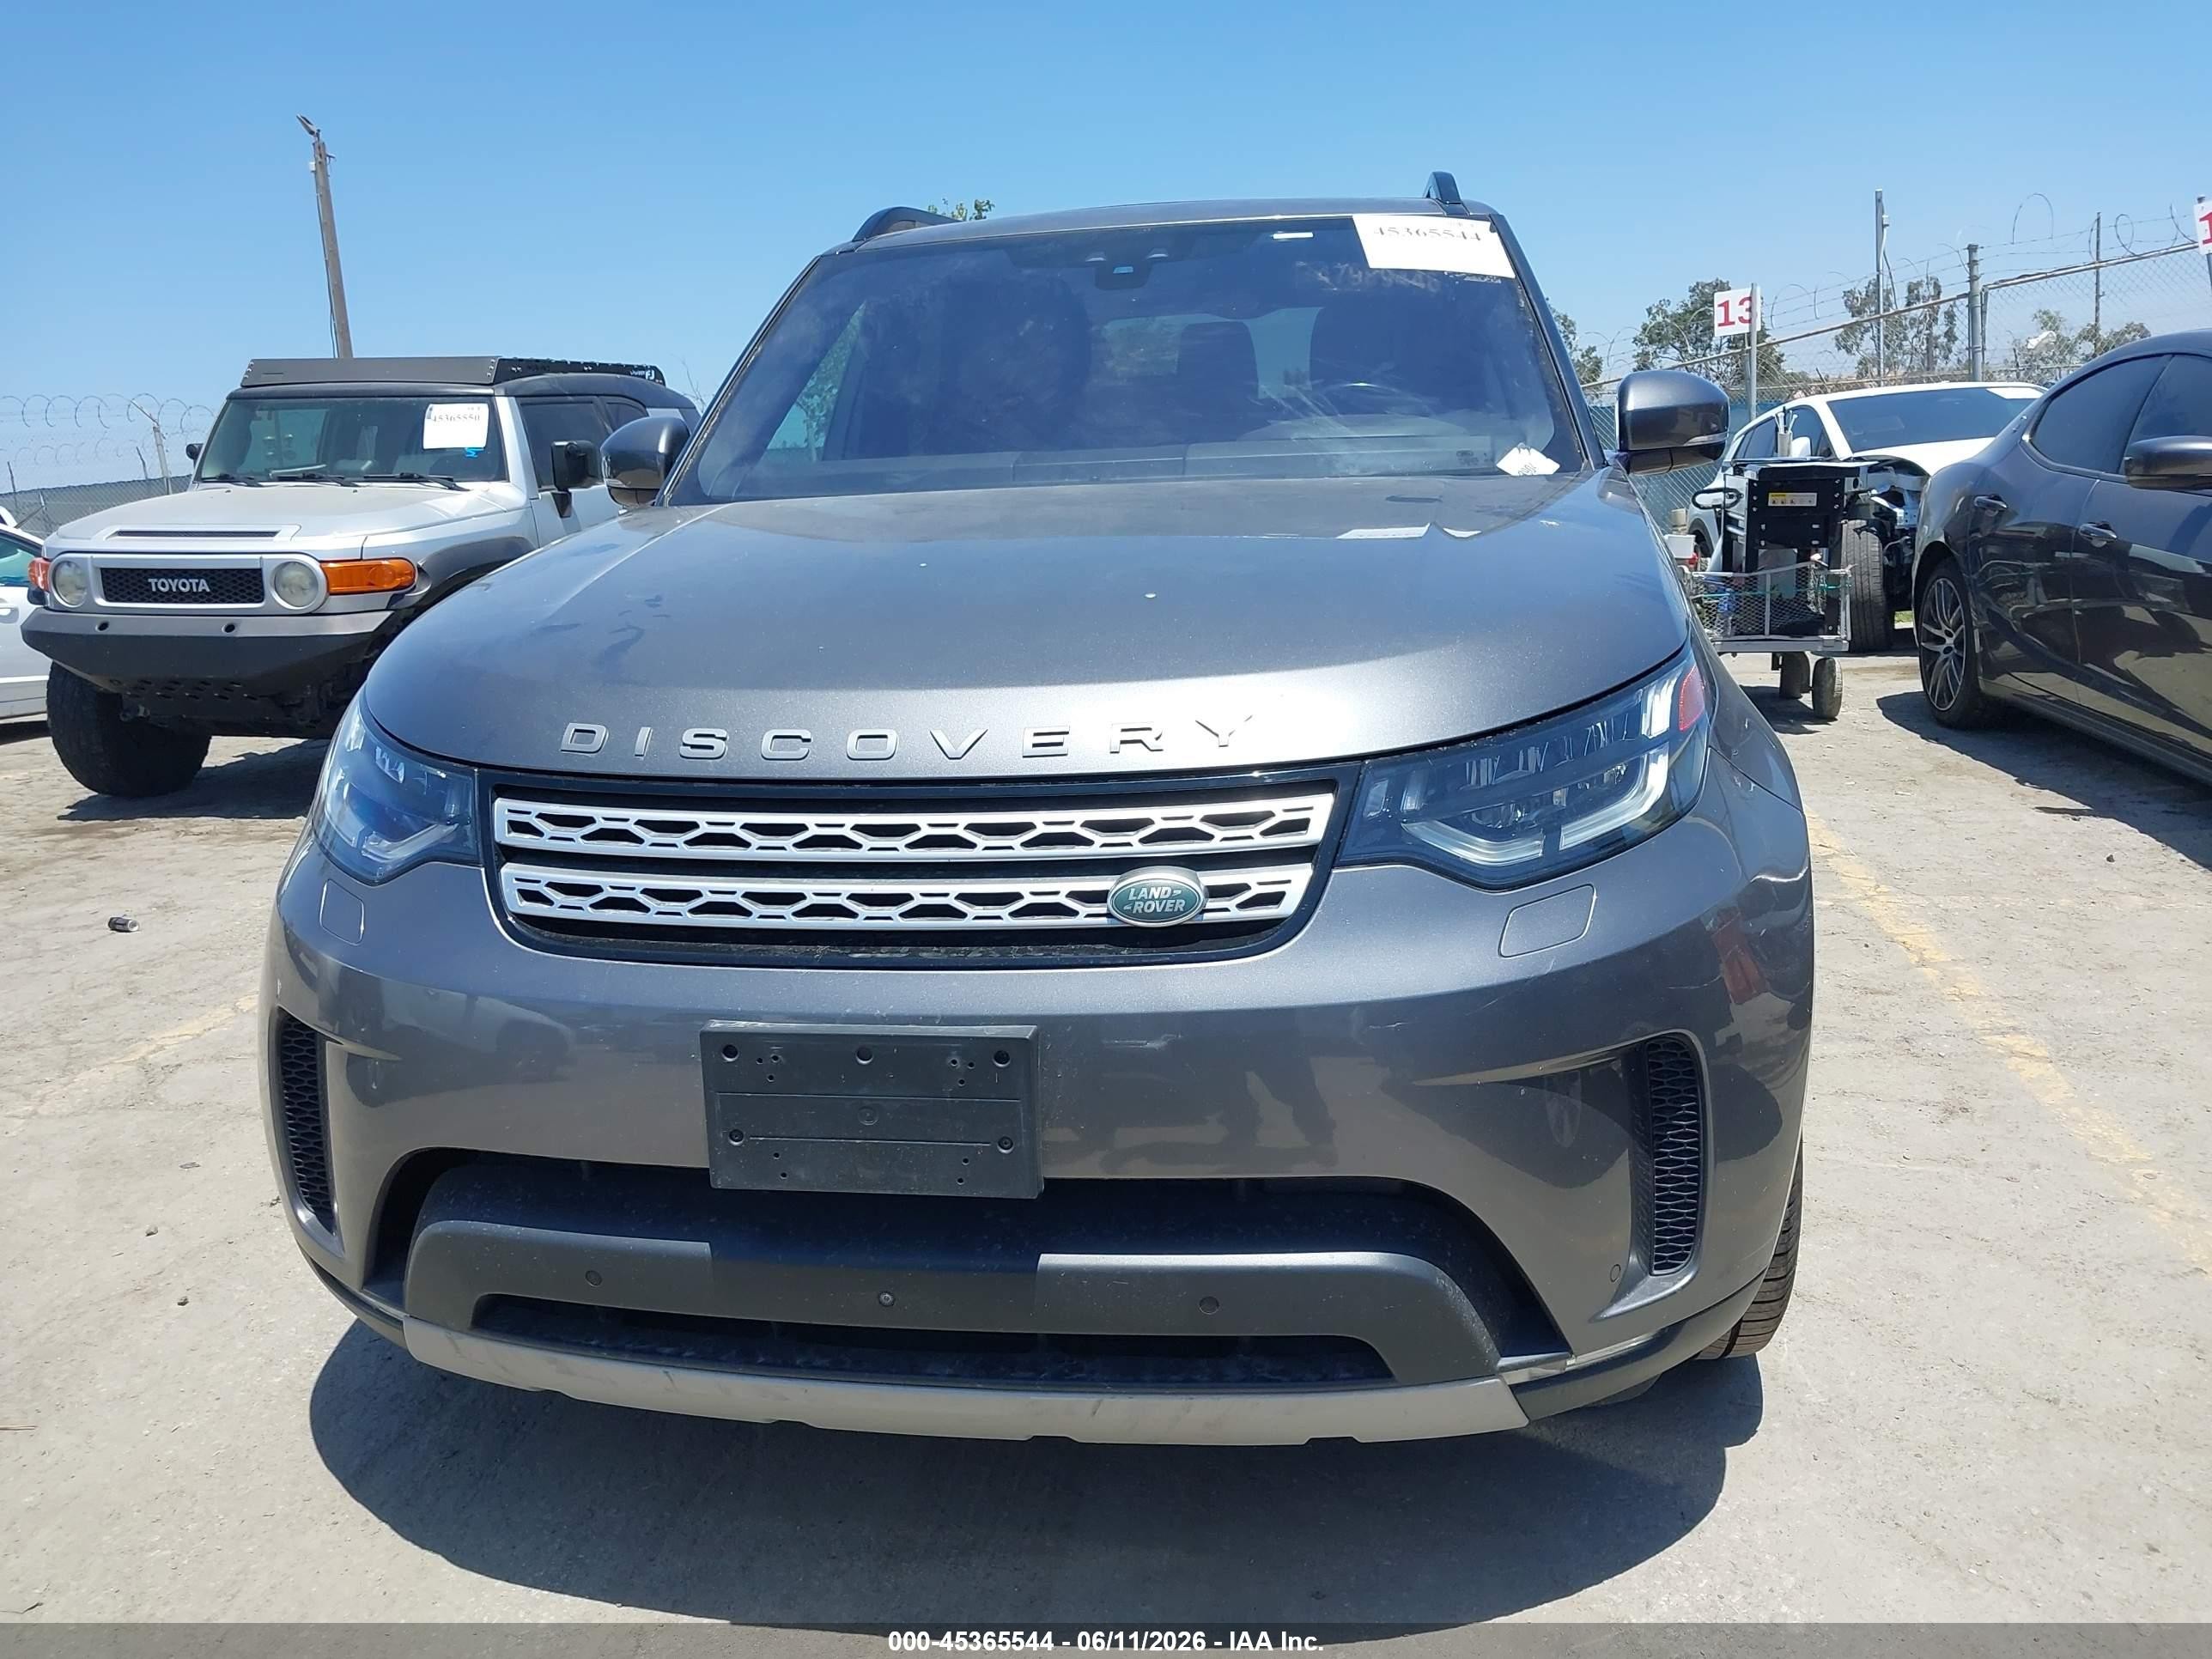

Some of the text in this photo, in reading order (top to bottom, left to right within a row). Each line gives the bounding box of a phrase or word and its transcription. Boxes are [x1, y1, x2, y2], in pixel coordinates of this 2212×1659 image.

[1374, 226, 1481, 241] 45365544
[1717, 296, 1758, 327] 13
[148, 578, 210, 592] TOYOTA
[560, 714, 1253, 760] DISCOVERY
[1128, 886, 1173, 900] LAND
[1133, 899, 1186, 914] ROVER
